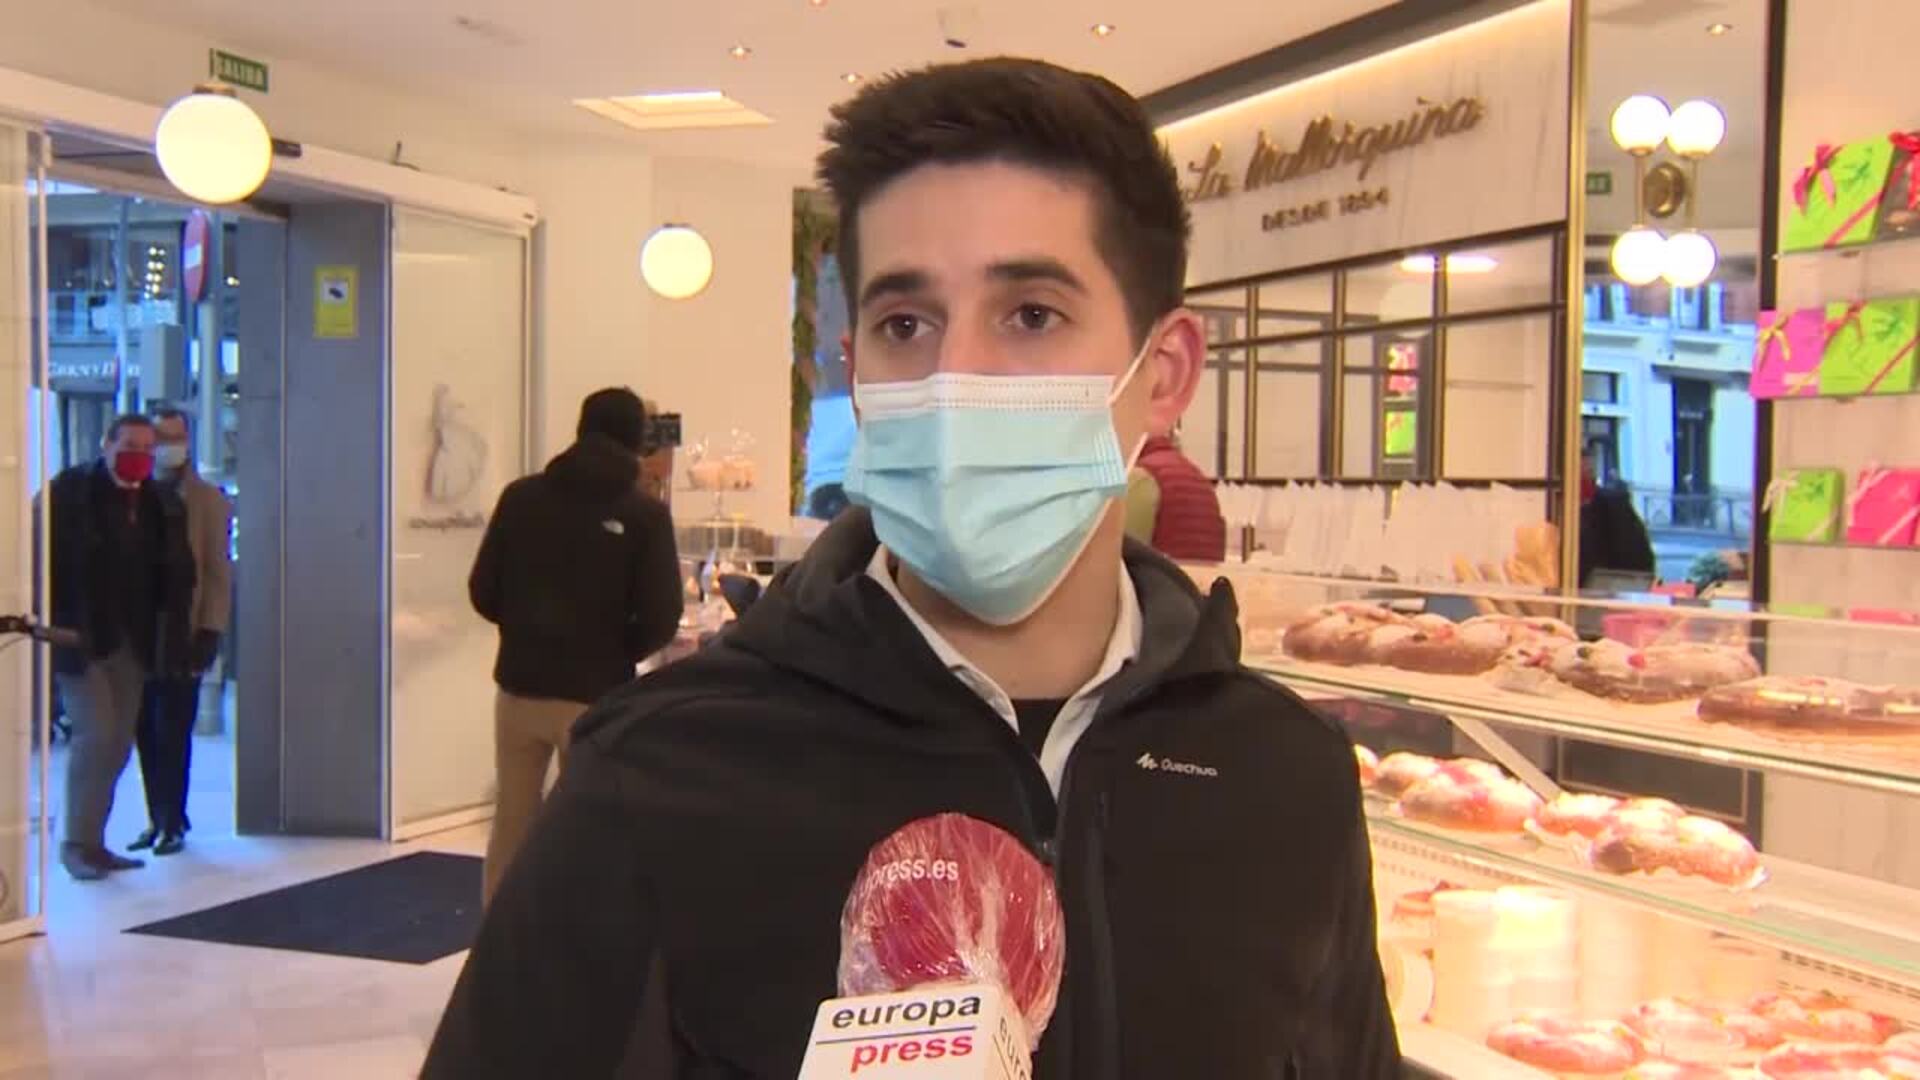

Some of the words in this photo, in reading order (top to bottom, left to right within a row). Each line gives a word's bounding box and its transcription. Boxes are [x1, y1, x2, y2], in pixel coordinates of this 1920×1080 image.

[1184, 141, 1231, 203] La
[1243, 95, 1485, 192] Mallorquina
[1261, 199, 1328, 231] DESDE
[1160, 757, 1218, 776] Quechua
[832, 995, 981, 1029] europa
[850, 1034, 973, 1073] press
